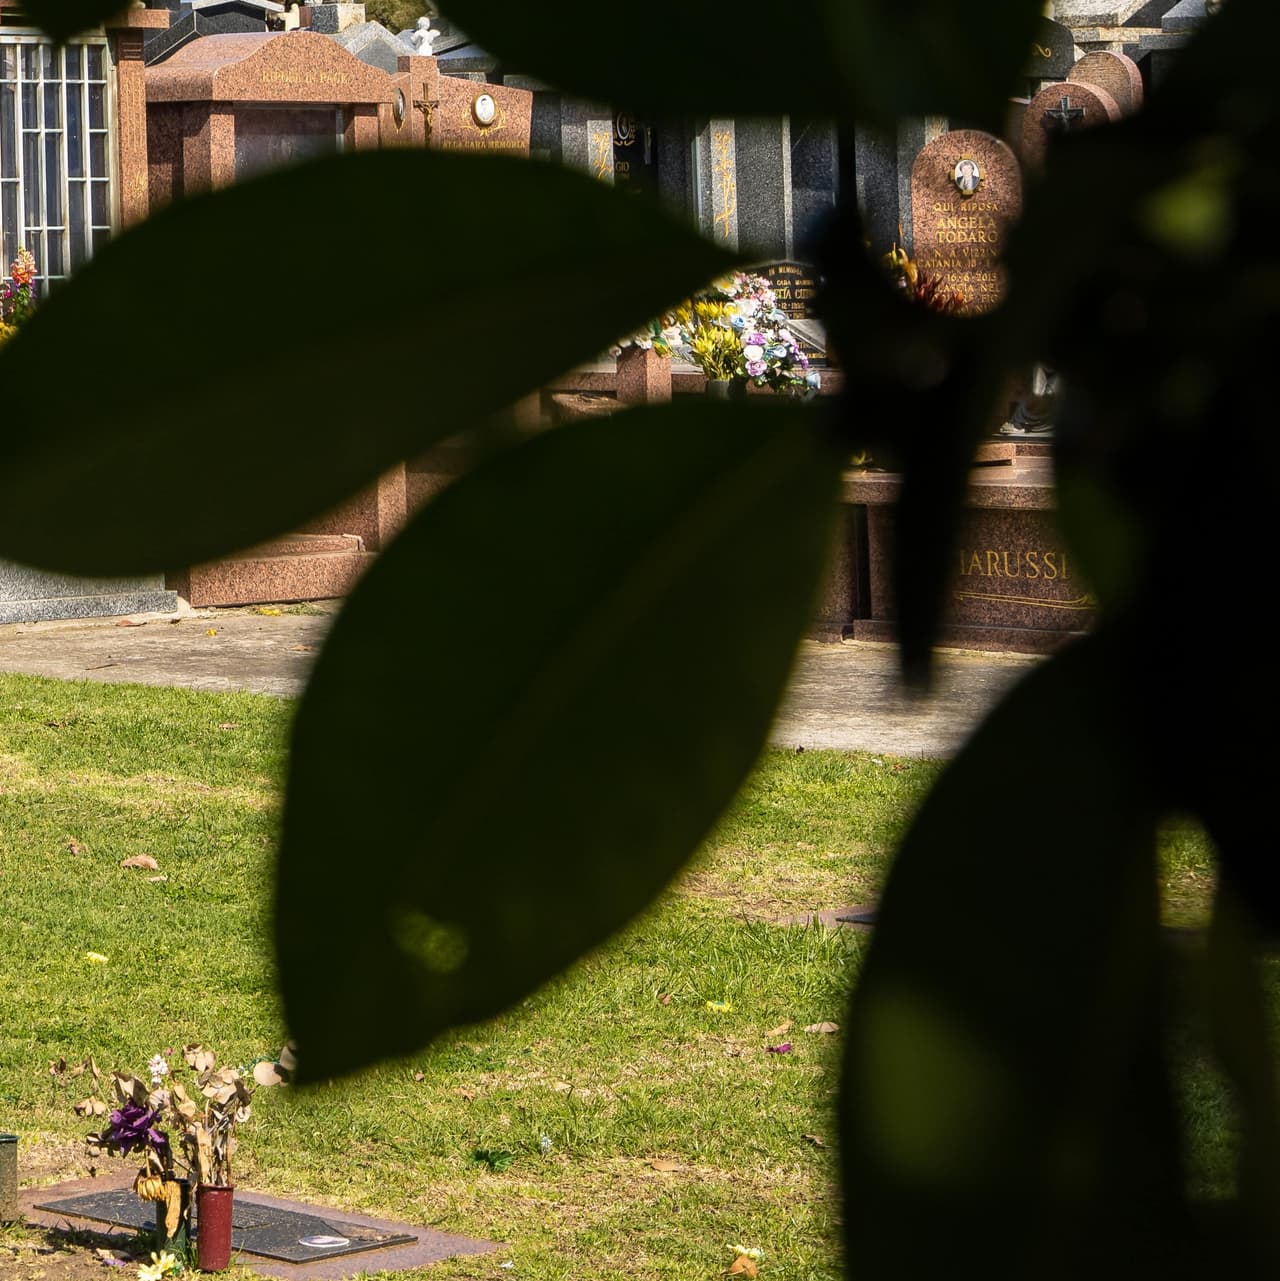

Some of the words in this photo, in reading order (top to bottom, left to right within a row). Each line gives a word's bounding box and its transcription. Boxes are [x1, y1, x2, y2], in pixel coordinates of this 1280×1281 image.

[934, 203, 954, 211] QUI
[961, 202, 998, 211] RIPOSA
[936, 217, 996, 229] ANGELA
[936, 231, 998, 243] TODARO
